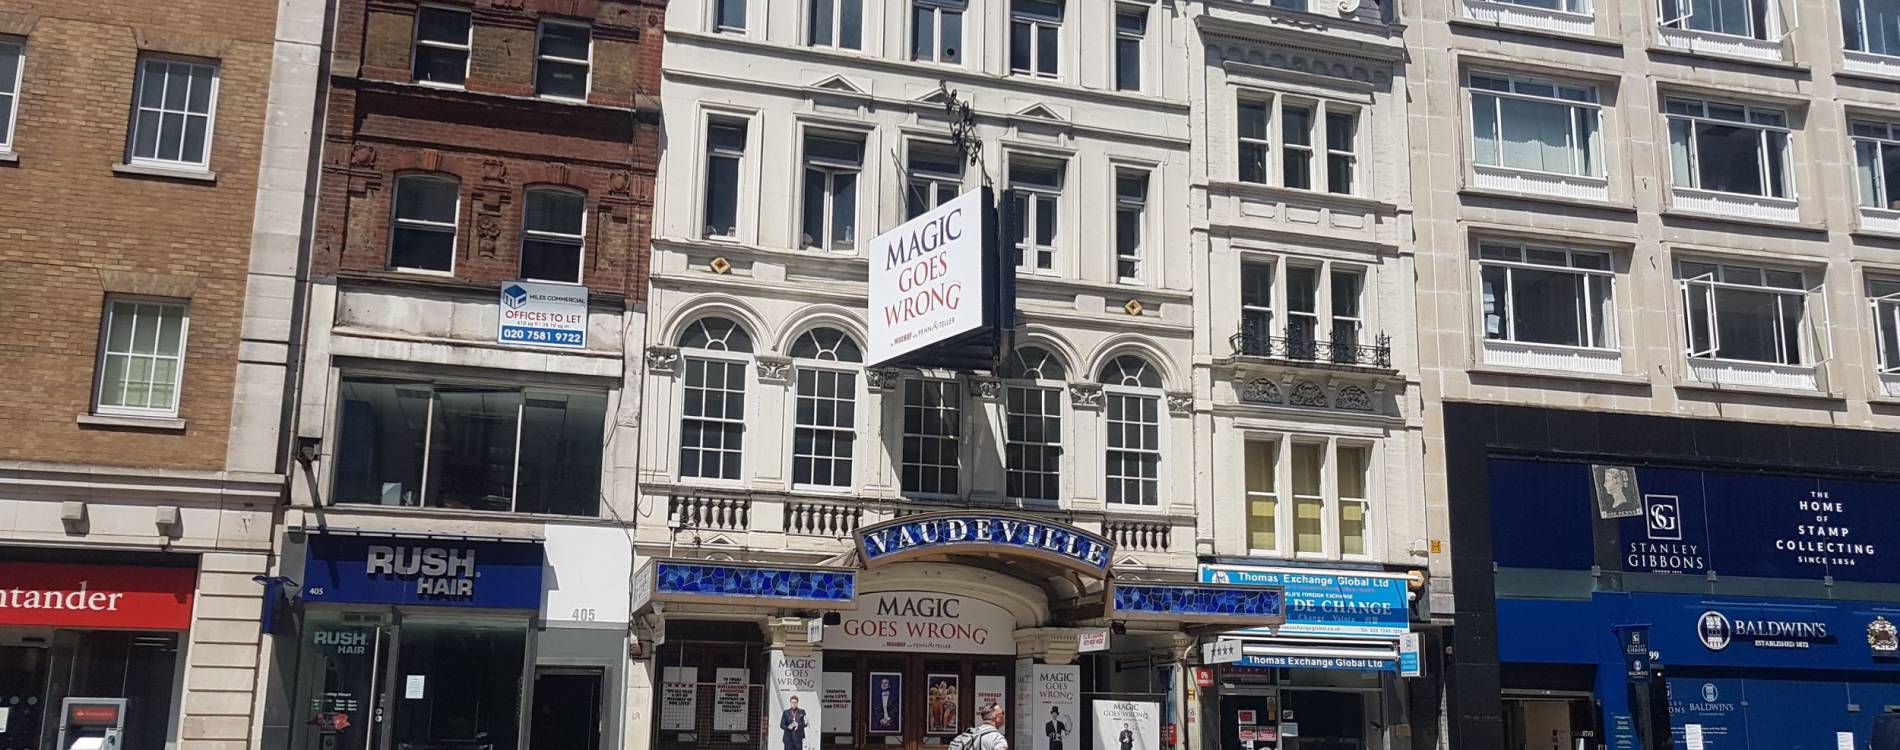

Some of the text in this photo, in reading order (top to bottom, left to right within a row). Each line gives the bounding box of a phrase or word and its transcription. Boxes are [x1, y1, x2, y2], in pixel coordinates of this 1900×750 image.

[885, 208, 962, 271] MAGIC
[898, 251, 947, 293] GOES
[547, 295, 586, 303] COMMERCIAL
[883, 282, 962, 328] WRONG
[505, 310, 582, 324] OFFICES TO LET
[504, 329, 581, 343] 020 7581 9722
[1810, 491, 1829, 499] THE
[1799, 501, 1843, 512] HOME
[1798, 525, 1849, 537] STAMP
[869, 518, 1106, 565] VAUDEVILLE
[1776, 540, 1874, 555] COLLECTING
[1631, 542, 1697, 555] STANLEY
[1628, 554, 1703, 570] GIBBONS
[1798, 556, 1828, 564] SINCE
[1238, 572, 1389, 588] Thomas Exchange Global Ltd
[309, 587, 324, 596] 405
[416, 577, 473, 596] HAIR
[877, 595, 960, 619] MAGIC
[1294, 598, 1392, 615] DE CHANGE
[572, 608, 596, 621] 405
[843, 619, 989, 645] GOES WRONG
[1734, 620, 1827, 638] BALDWIN'S
[1754, 639, 1795, 648] ESTABLISHED
[337, 645, 365, 655] HAIR
[778, 659, 816, 669] MAGIC
[1249, 656, 1383, 668] Thomas Exchange Global Ltd
[784, 669, 809, 677] GOES
[1040, 672, 1074, 682] MAGIC
[777, 677, 815, 688] WRONG
[1045, 682, 1068, 690] GOES
[1040, 690, 1073, 700] WRONG
[1689, 703, 1734, 712] BALDWIN'S
[1122, 711, 1149, 719] WRONG
